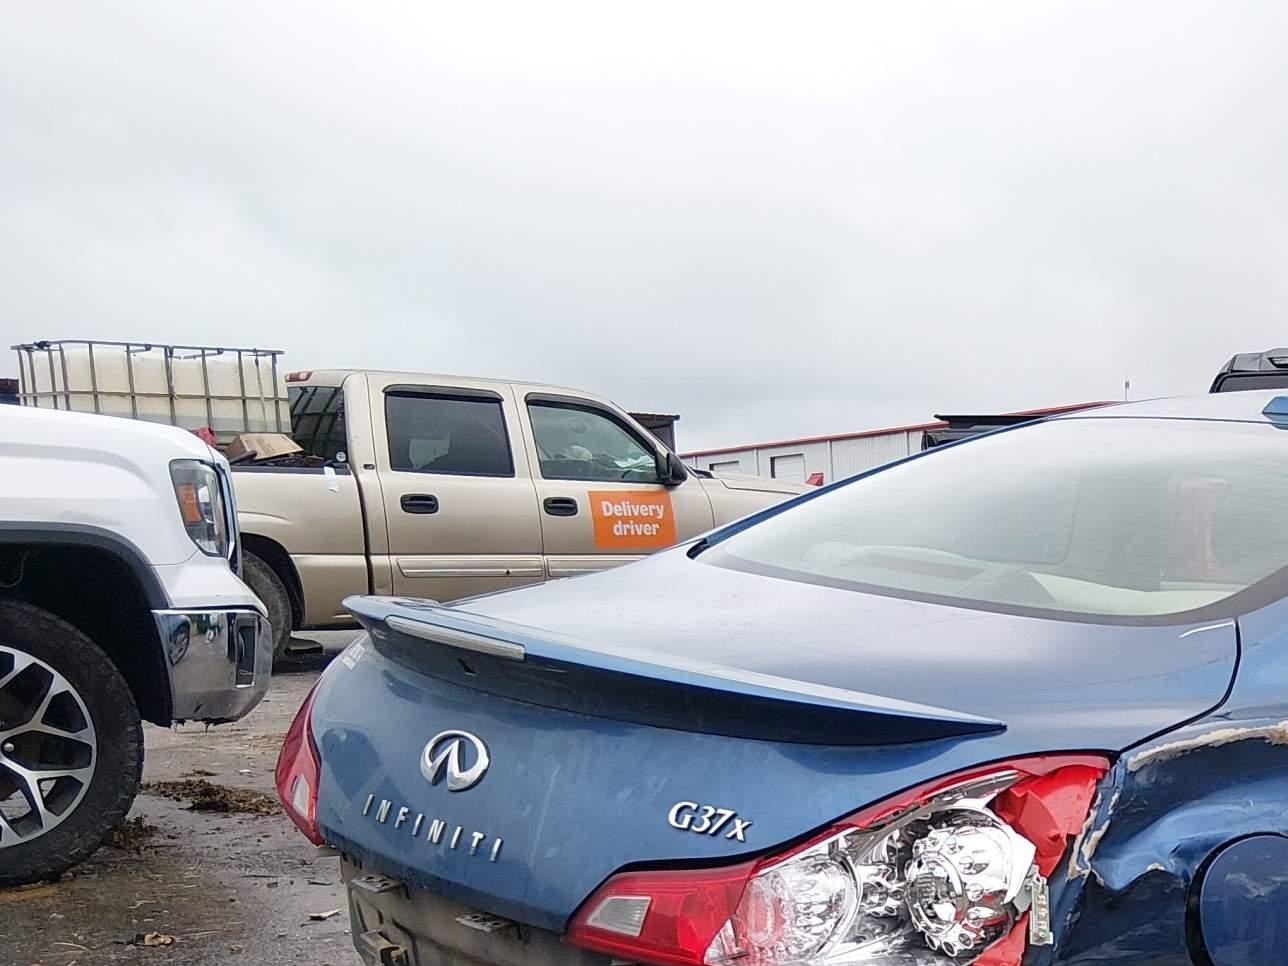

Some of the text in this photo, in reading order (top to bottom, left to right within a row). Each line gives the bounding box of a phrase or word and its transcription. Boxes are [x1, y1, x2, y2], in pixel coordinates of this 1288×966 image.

[601, 500, 664, 519] Delivery
[613, 520, 660, 536] driver
[362, 793, 504, 863] INFINITI
